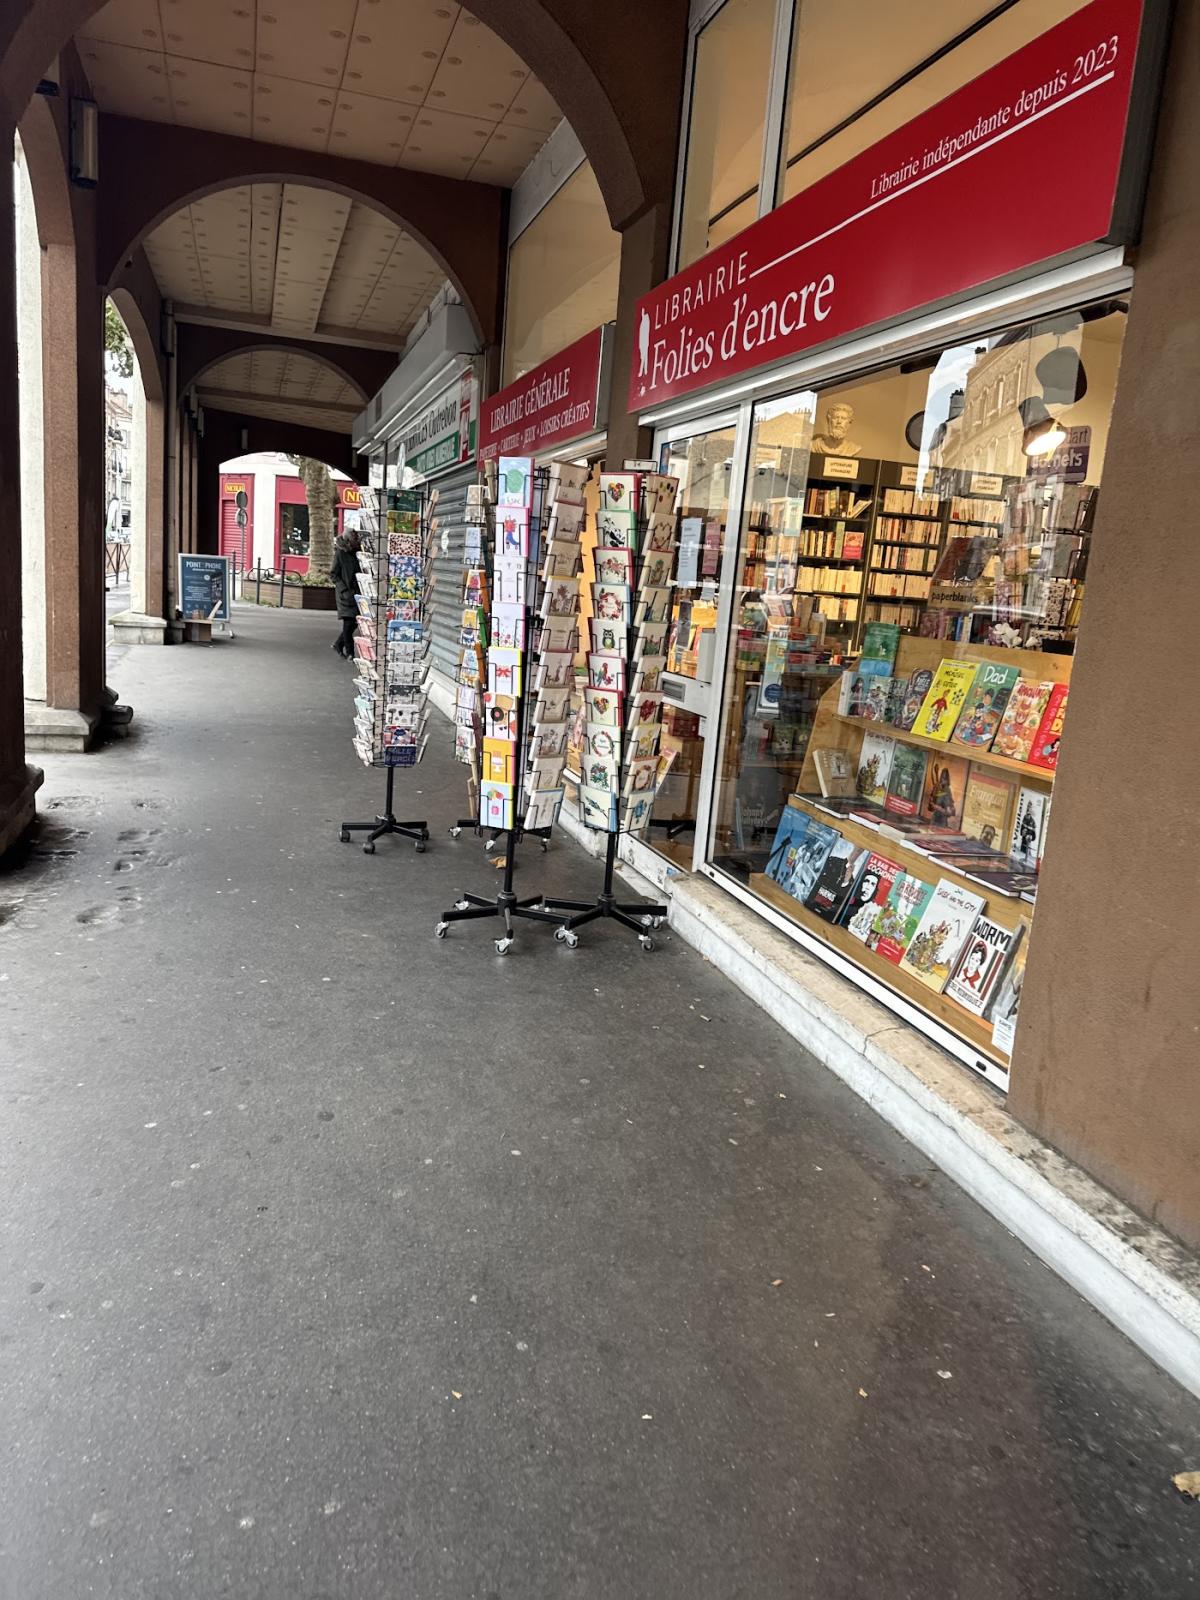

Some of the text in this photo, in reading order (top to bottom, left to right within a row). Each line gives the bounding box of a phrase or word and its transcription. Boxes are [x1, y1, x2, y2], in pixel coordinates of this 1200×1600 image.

[870, 35, 1118, 199] Librairie indépendante depuis 2023
[654, 251, 748, 330] LIBRAIRIE
[649, 273, 835, 390] Folies d'encre
[490, 395, 523, 433] LIBRAIRIE
[524, 367, 571, 416] GÉNÉRALE
[522, 425, 537, 448] JEUX
[540, 414, 560, 437] LOISIRS
[560, 400, 591, 428] CRÉATIFS
[204, 562, 222, 570] PHONE
[983, 666, 1009, 684] Dad
[868, 863, 896, 881] COCHONS
[877, 860, 889, 870] BAIE
[963, 902, 977, 912] CITY
[972, 917, 1012, 951] WORM
